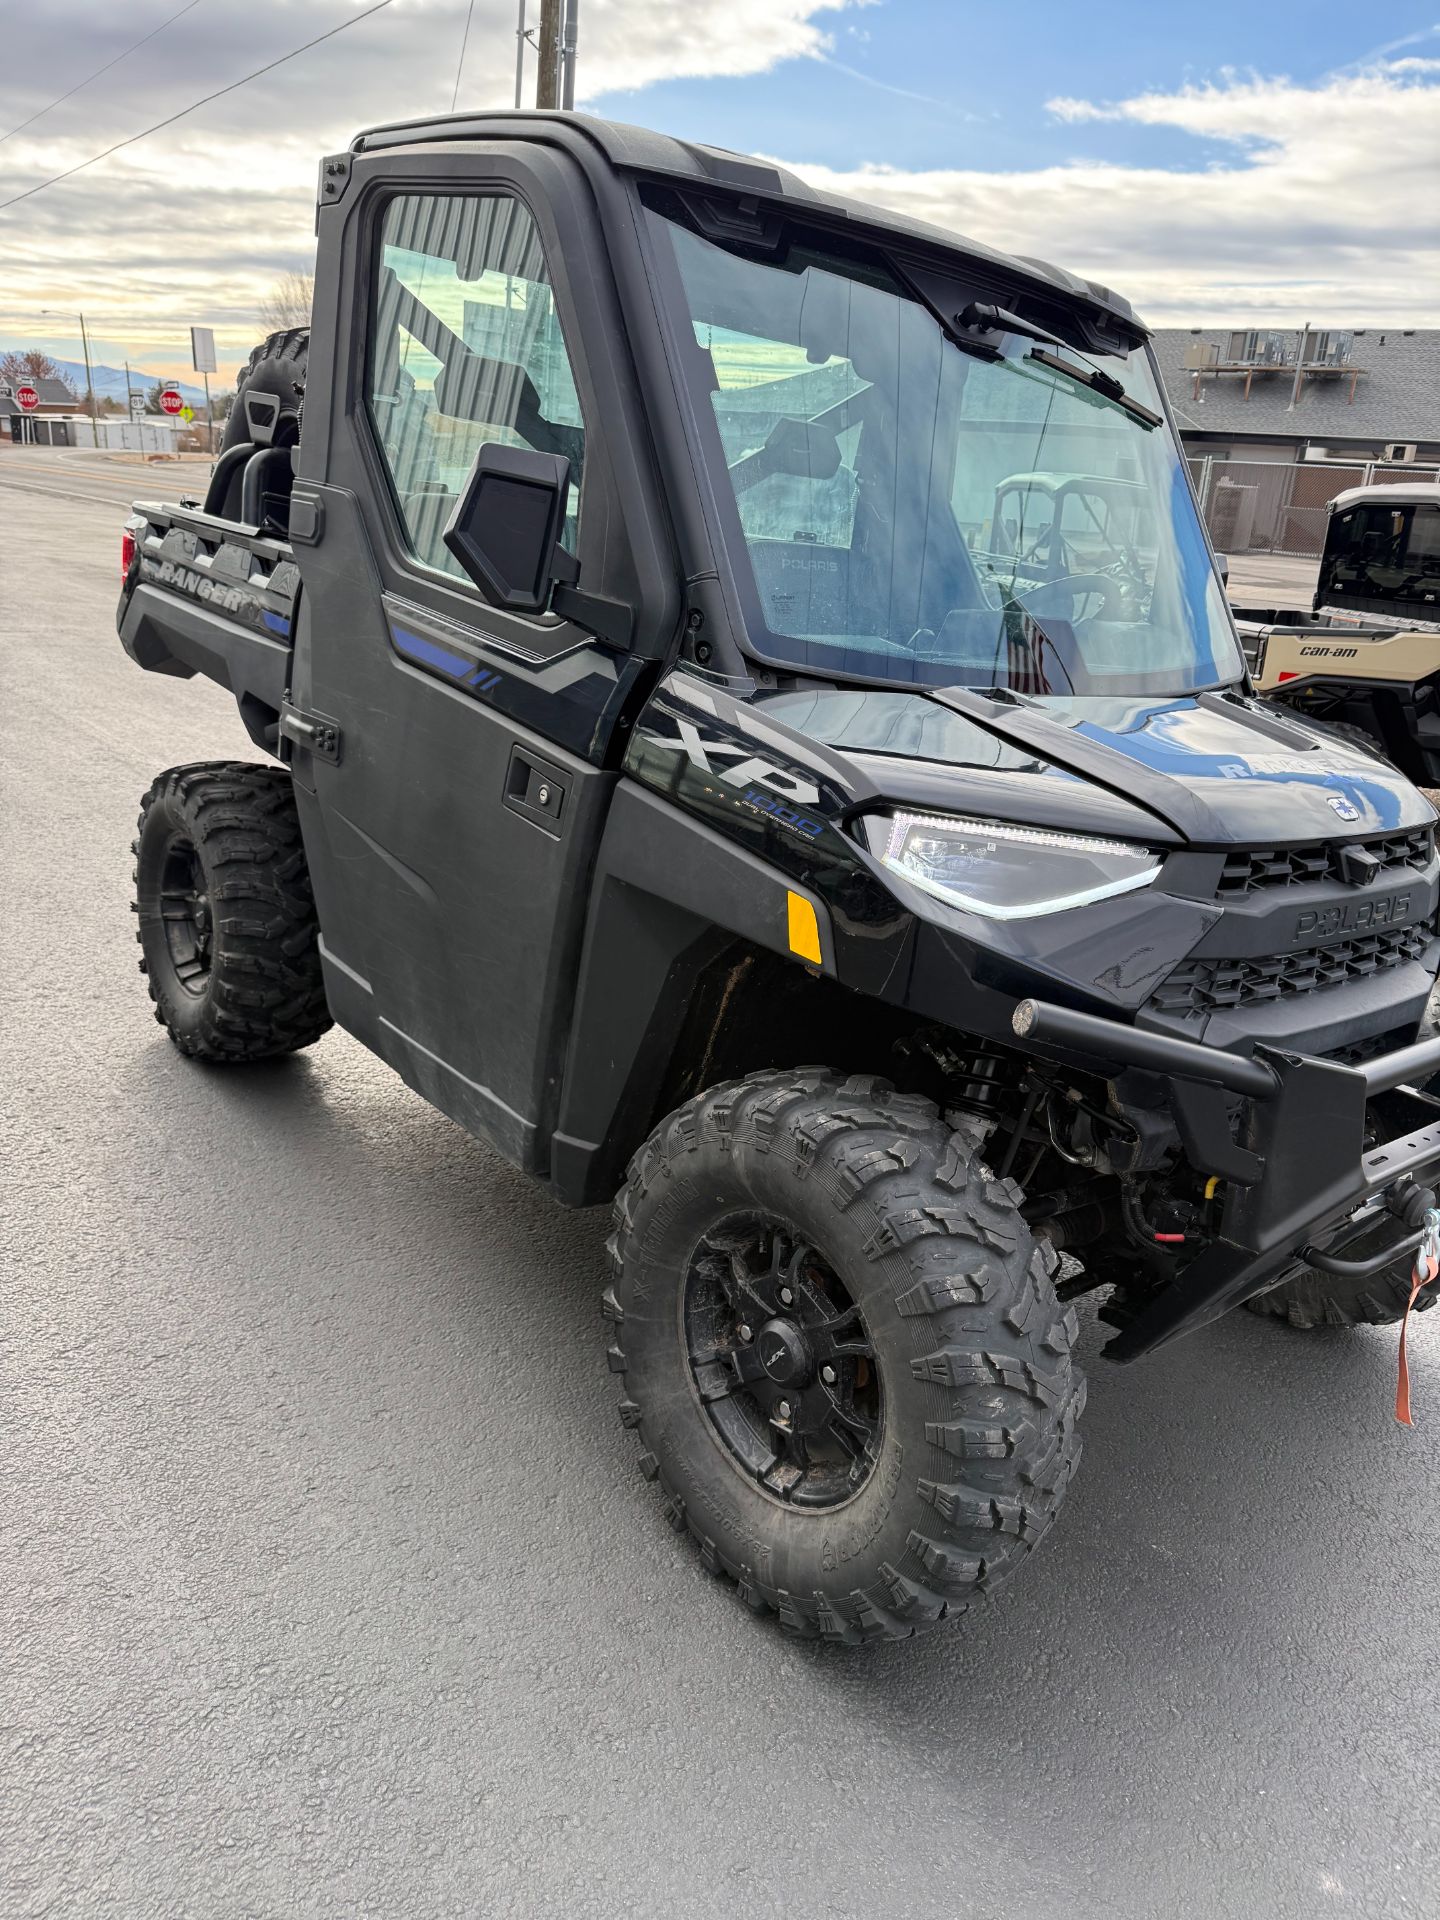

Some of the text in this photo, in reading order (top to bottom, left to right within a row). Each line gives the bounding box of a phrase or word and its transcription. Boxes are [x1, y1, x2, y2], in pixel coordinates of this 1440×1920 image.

[18, 393, 37, 403] STOP
[162, 397, 182, 407] STOP
[781, 558, 839, 572] POLARIS
[158, 561, 242, 612] RANGER
[1299, 646, 1359, 658] can-am
[641, 718, 820, 804] XP
[1216, 758, 1355, 779] RANGER
[743, 790, 824, 835] 1000
[760, 810, 799, 832] OVERHEAD
[798, 830, 816, 841] CAM
[1292, 892, 1412, 943] POLARIS
